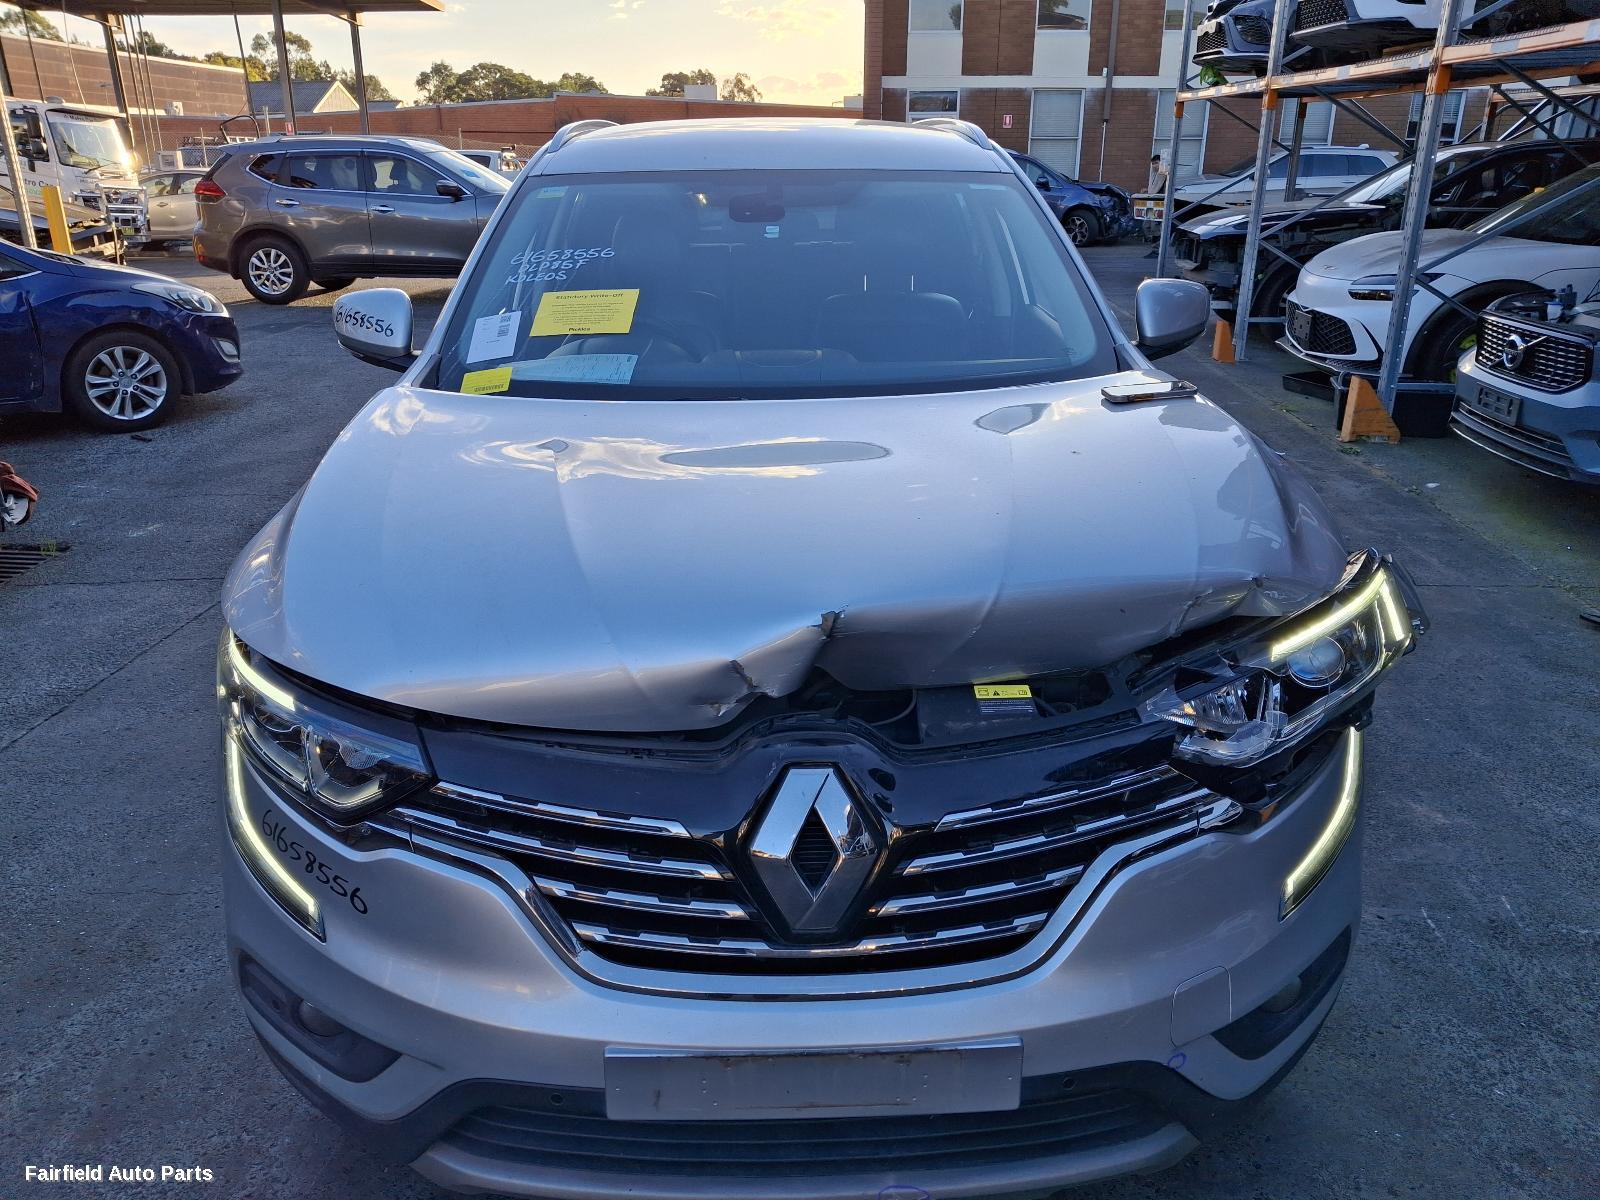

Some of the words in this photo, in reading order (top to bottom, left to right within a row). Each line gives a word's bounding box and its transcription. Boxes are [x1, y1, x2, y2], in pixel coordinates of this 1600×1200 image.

[510, 247, 615, 265] 61658556
[504, 270, 568, 285] KOLEOS
[334, 305, 394, 338] 61658556
[262, 809, 368, 915] 61658556
